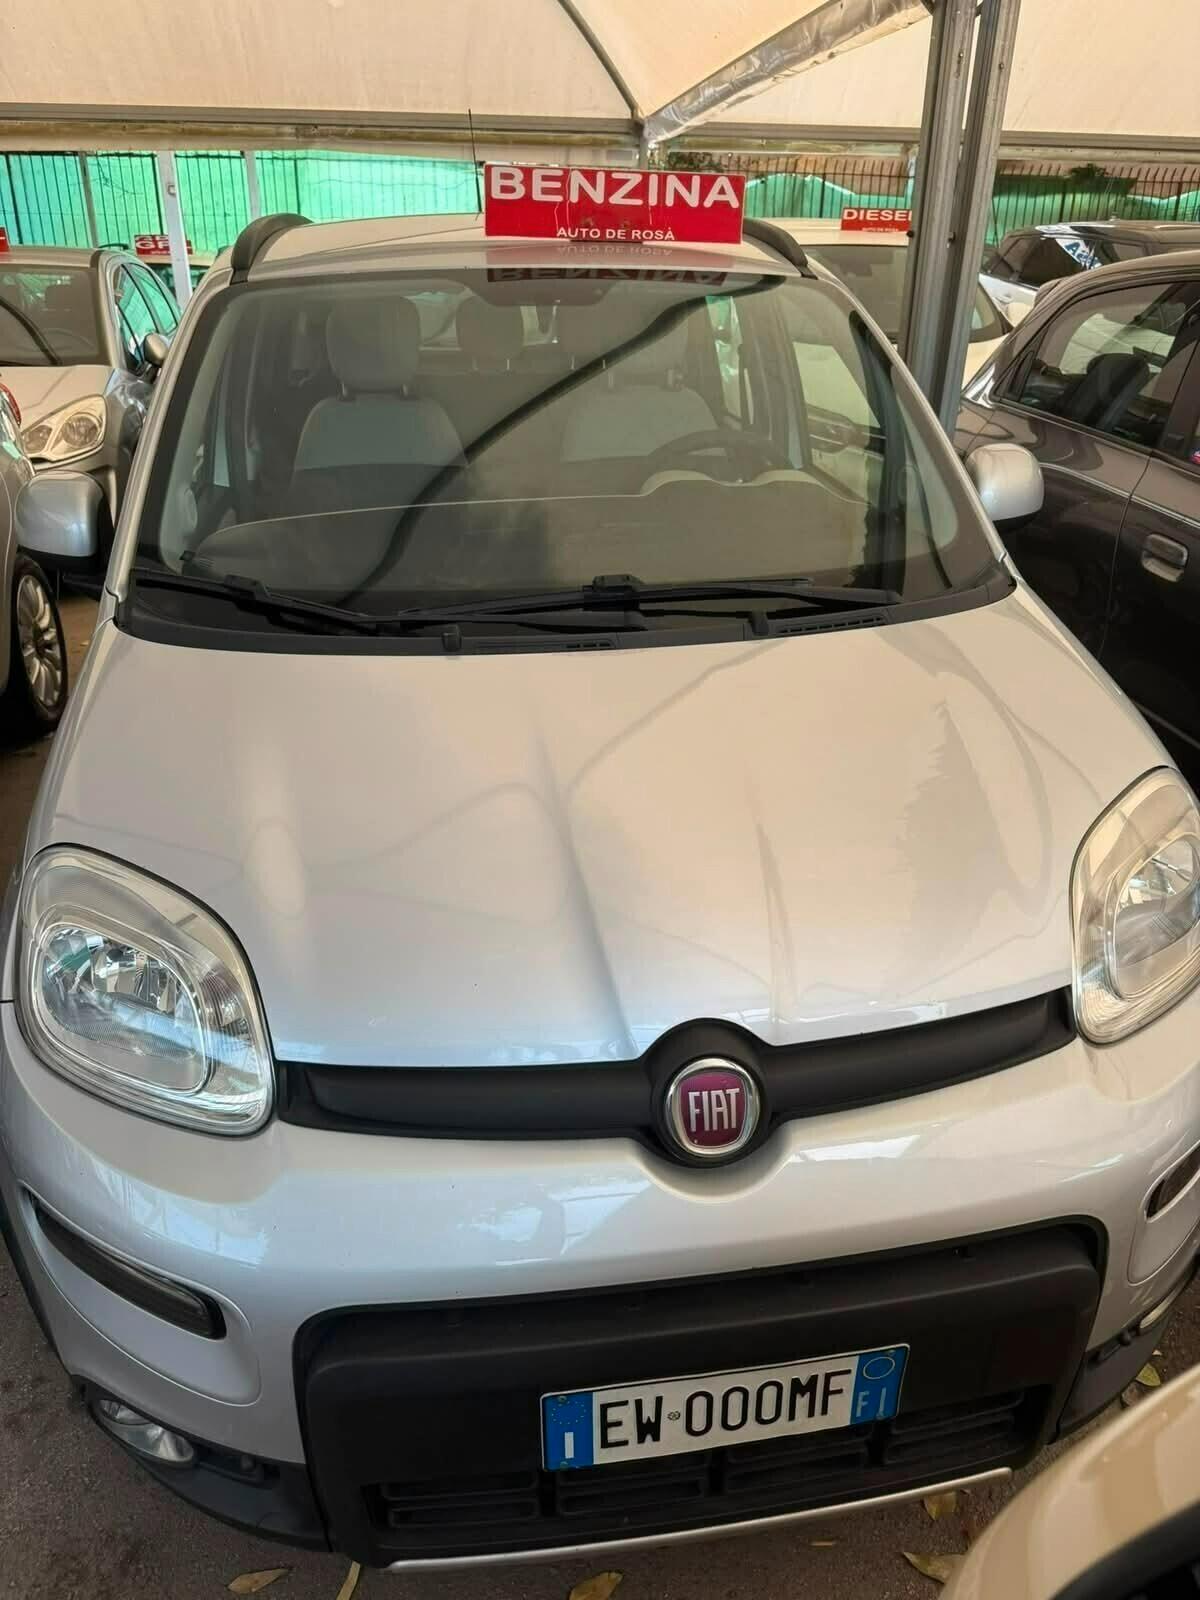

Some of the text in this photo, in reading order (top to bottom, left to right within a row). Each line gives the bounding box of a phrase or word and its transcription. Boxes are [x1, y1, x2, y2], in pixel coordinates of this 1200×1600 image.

[490, 166, 740, 208] BENZINA
[557, 227, 601, 239] AUTO
[605, 228, 626, 240] DE
[688, 1088, 740, 1132] FIAT
[600, 1396, 663, 1449] EW
[564, 1432, 575, 1459] I
